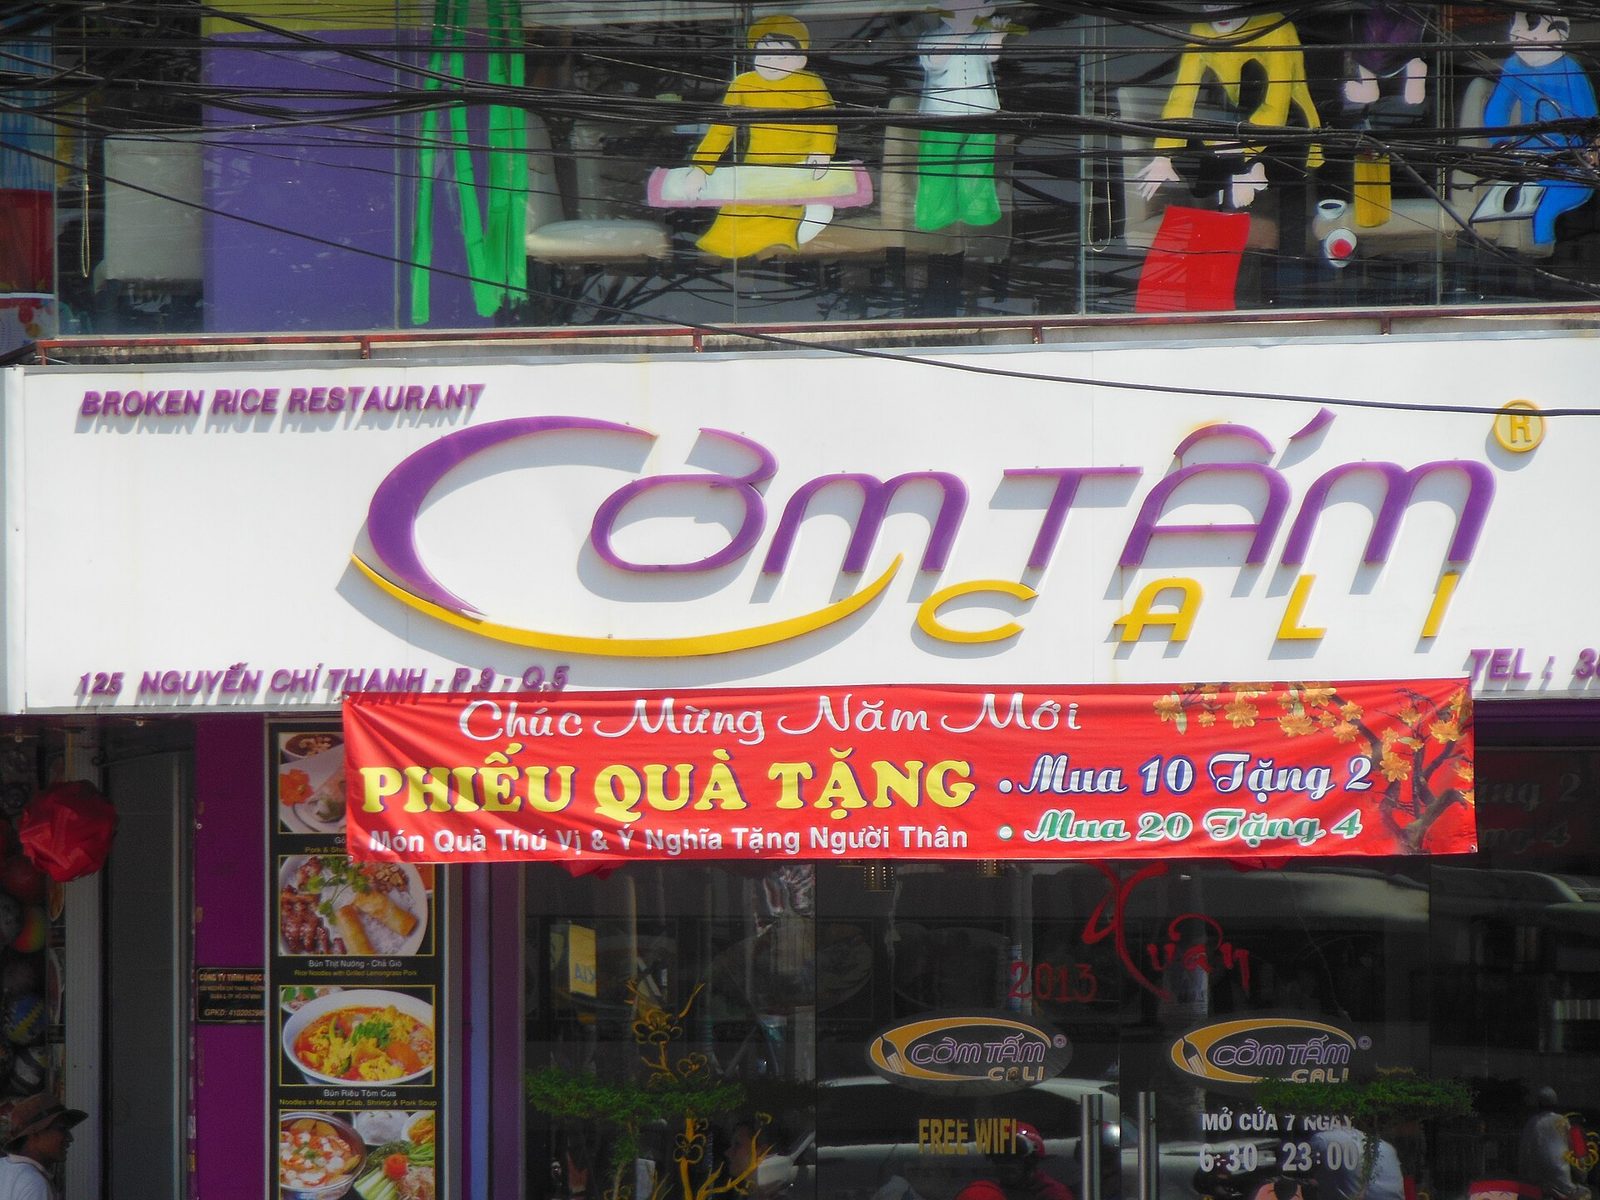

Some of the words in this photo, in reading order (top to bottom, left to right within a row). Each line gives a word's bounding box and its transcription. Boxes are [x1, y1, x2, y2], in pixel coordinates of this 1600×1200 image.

[81, 391, 205, 417] BROKEN
[212, 388, 281, 415] RICE
[288, 383, 486, 413] RESTAURANT
[916, 571, 1460, 644] CALI
[79, 671, 126, 696] 125
[270, 662, 325, 694] CHÍ
[328, 668, 429, 693] THANH
[453, 667, 497, 693] P.9
[522, 665, 571, 692] Q.5
[1470, 647, 1533, 681] TEL
[458, 699, 583, 741] Chúc
[592, 697, 766, 746] Mừng
[777, 693, 931, 735] Năm
[940, 692, 1082, 733] Mới
[359, 742, 577, 813] PHIẾU
[593, 748, 748, 823] QUÀ
[767, 746, 976, 820] TẶNG
[1018, 753, 1129, 794] Mua
[1139, 754, 1197, 796] 10
[1207, 752, 1337, 803] Tặng
[1344, 756, 1373, 792] 2
[368, 829, 425, 853] Món
[434, 829, 487, 853] Quà
[495, 829, 548, 851] Thú
[556, 829, 582, 855] Vị
[591, 829, 610, 851] &
[616, 823, 635, 851] Ý
[645, 827, 723, 856] Nghĩa
[731, 827, 801, 855] Tặng
[810, 826, 890, 855] Người
[898, 825, 969, 849] Thân
[1023, 809, 1132, 843] Mua
[1135, 811, 1194, 842] 20
[1203, 808, 1327, 848] Tặng
[1330, 808, 1363, 840] 4
[1007, 961, 1098, 1002] 2013
[1290, 1067, 1350, 1084] CALI
[918, 1117, 969, 1155] FREE
[974, 1117, 1018, 1155] WIFI
[1202, 1106, 1233, 1132] MỞ
[1238, 1106, 1279, 1132] CỬA
[1284, 1114, 1296, 1132] 7
